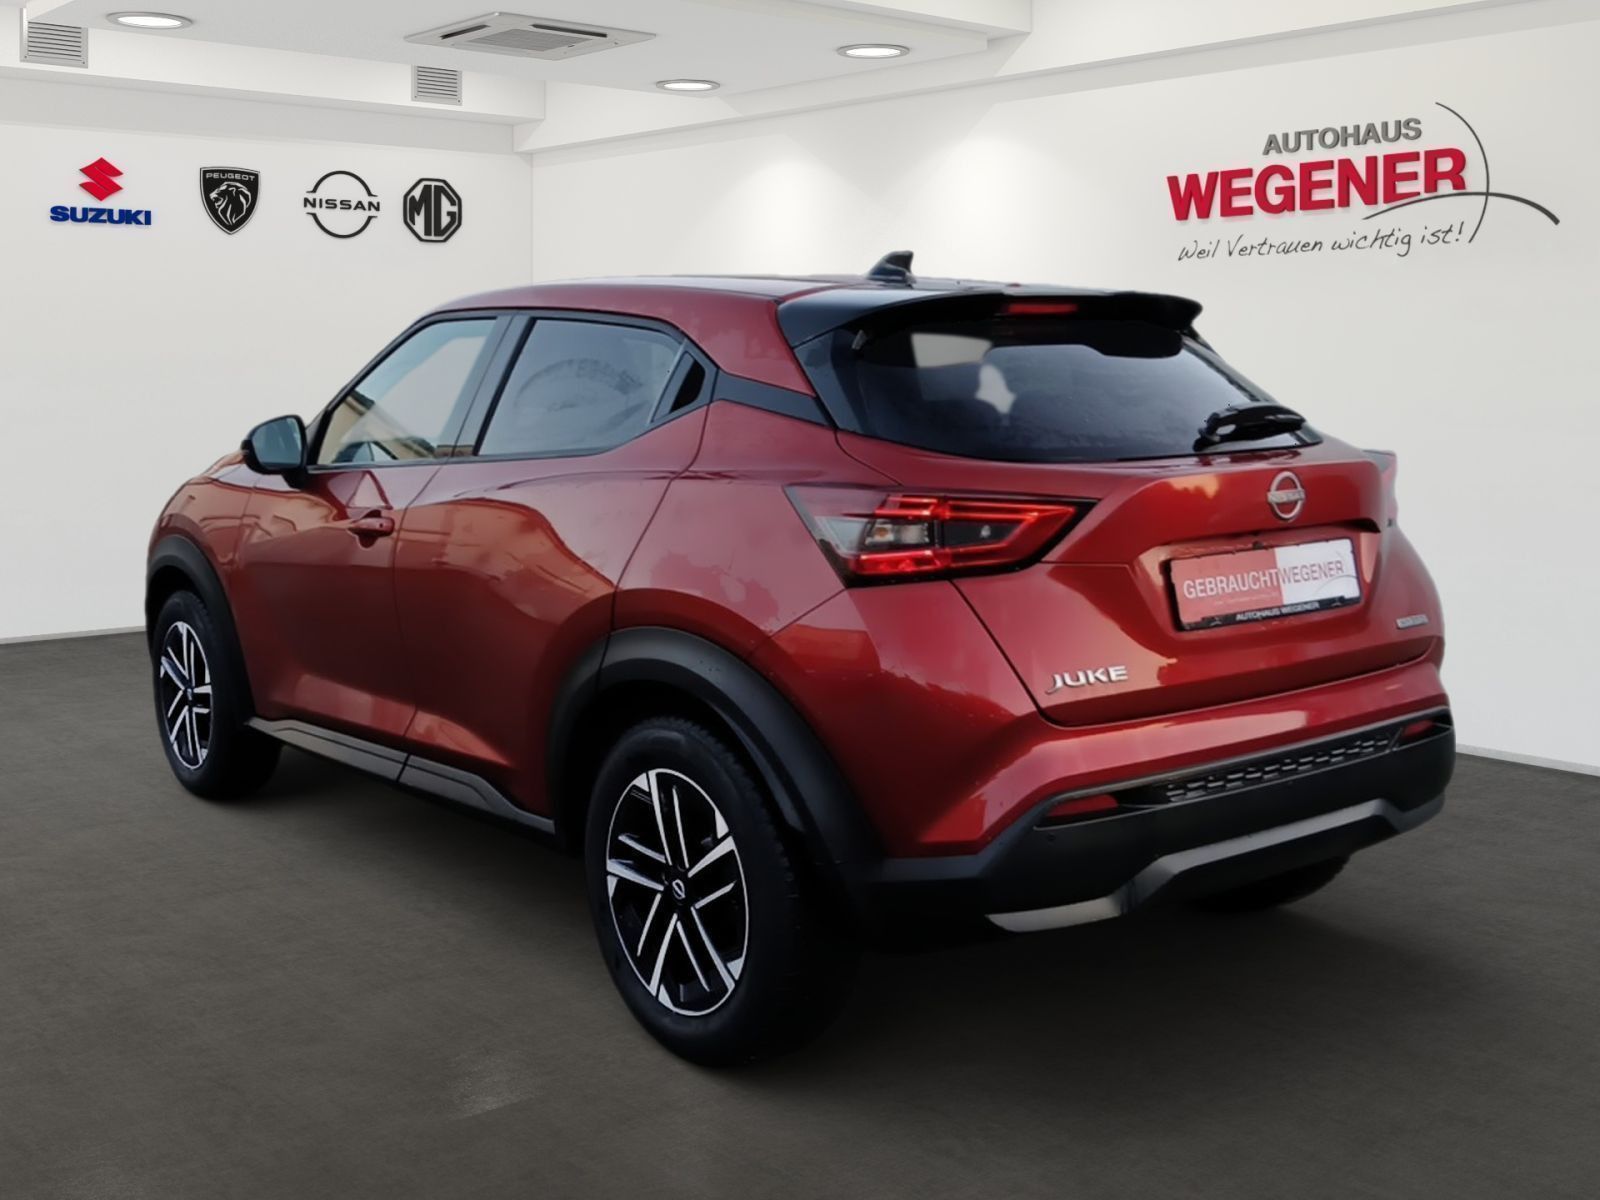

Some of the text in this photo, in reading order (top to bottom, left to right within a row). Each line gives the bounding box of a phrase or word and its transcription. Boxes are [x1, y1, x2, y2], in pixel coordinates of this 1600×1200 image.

[1262, 117, 1423, 156] AUTOHAUS
[205, 172, 256, 182] PEUGEOT
[1166, 147, 1467, 222] WEGENER
[49, 205, 152, 226] SUZUKI
[303, 197, 381, 212] NISSAN
[408, 184, 457, 237] MG
[1226, 233, 1324, 258] Vertrauen
[1331, 228, 1413, 258] wichtig
[1420, 220, 1466, 246] ist!
[1235, 601, 1321, 622] AUTOHAUS WEGENER
[1044, 664, 1129, 695] JUKE
